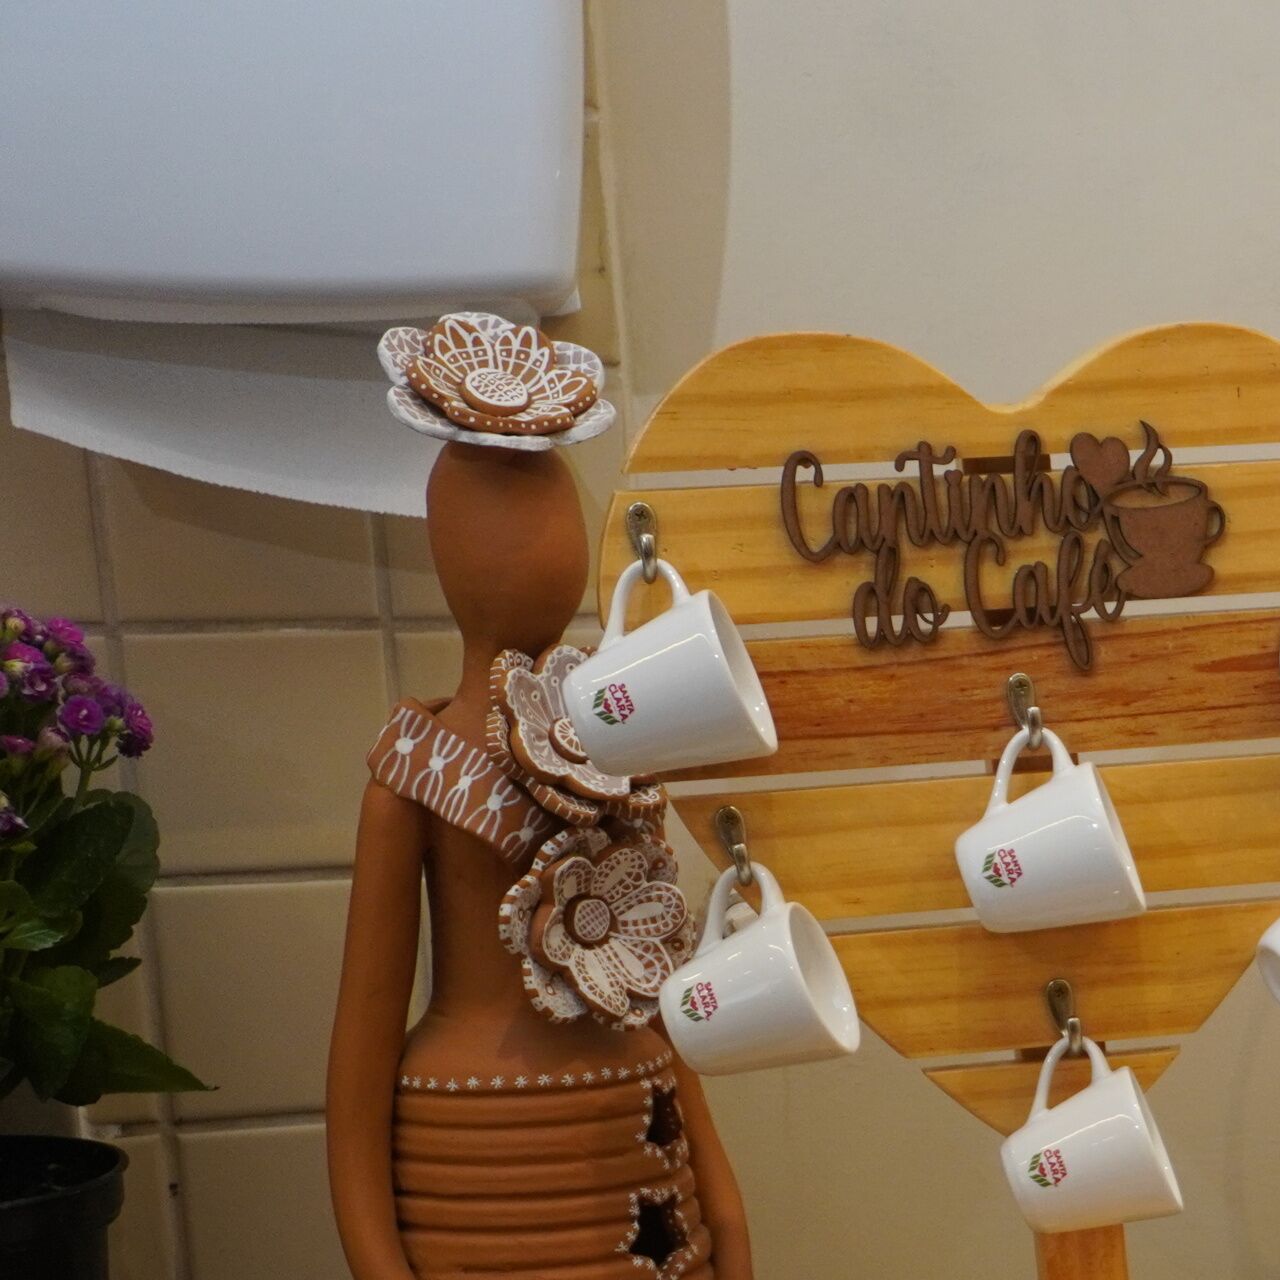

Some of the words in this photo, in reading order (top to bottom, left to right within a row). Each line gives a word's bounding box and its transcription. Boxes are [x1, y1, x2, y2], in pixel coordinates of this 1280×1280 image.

[780, 429, 1104, 564] Cantinho
[608, 684, 628, 722] CLARA
[618, 683, 635, 715] SANTA
[998, 848, 1016, 887] CLARA
[696, 982, 712, 1021] CLARA
[1044, 1149, 1061, 1187] CLARA
[1053, 1149, 1068, 1179] SANTA
